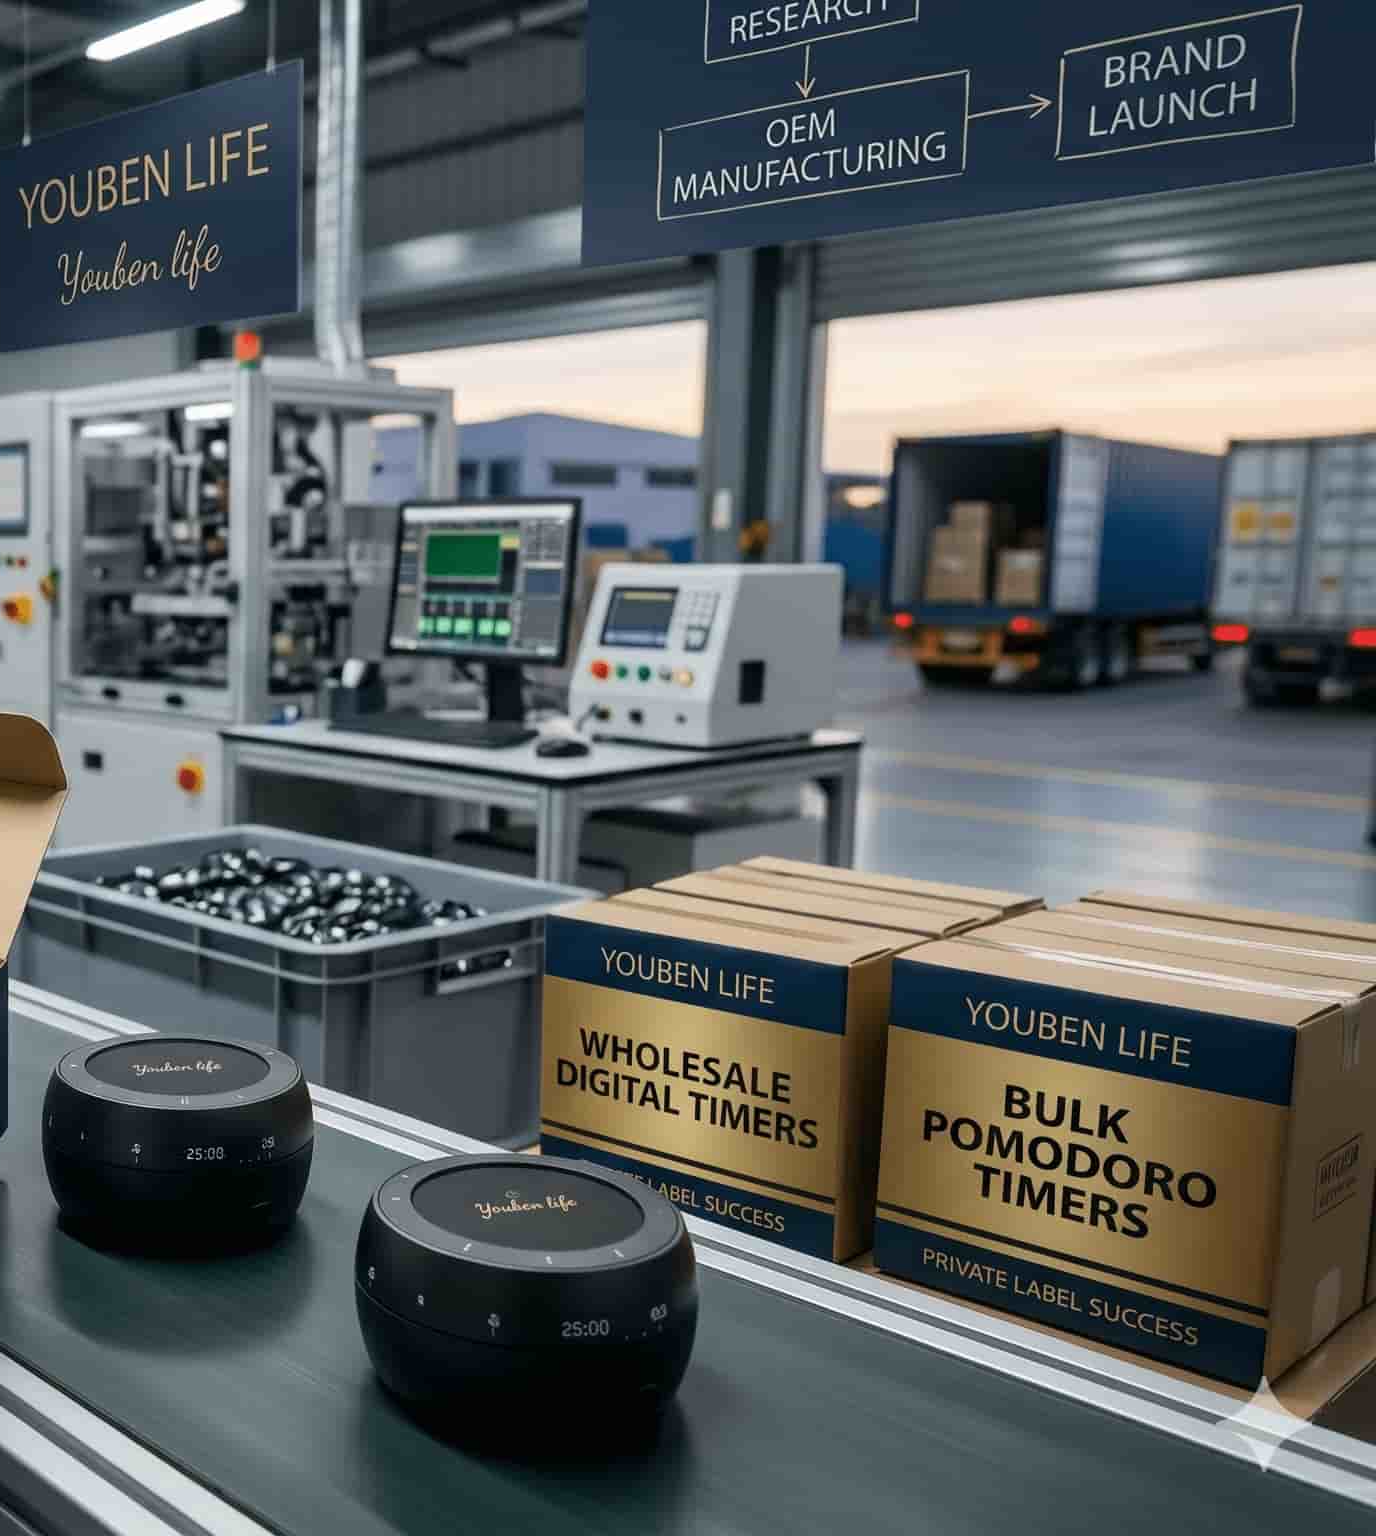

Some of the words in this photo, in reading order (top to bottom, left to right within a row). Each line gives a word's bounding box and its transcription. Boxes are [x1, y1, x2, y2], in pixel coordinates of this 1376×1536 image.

[1104, 33, 1247, 88] BRAND
[765, 107, 837, 148] OEM
[1088, 77, 1258, 137] LAUNCH
[18, 148, 171, 230] YOUBEN
[184, 122, 271, 192] LIFE
[673, 131, 948, 204] MANUFACTURING
[56, 240, 163, 306] Youben
[171, 223, 223, 291] life
[600, 946, 709, 993] YOUBEN
[718, 968, 775, 1005] LIFE
[579, 1026, 792, 1105] WHOLESALE
[964, 996, 1106, 1051] YOUBEN
[1117, 1025, 1193, 1068] LIFE
[556, 1057, 681, 1117] DIGITAL
[687, 1090, 819, 1149] TIMERS
[1003, 1083, 1131, 1144] BULK
[923, 1108, 1217, 1209] POMODORO
[703, 1194, 785, 1233] SUCCESS
[973, 1162, 1150, 1239] TIMERS
[561, 1319, 610, 1337] 25:00
[922, 1247, 1009, 1289] PRIVATE
[1013, 1275, 1082, 1313] LABEL
[1088, 1297, 1199, 1346] SUCCESS
